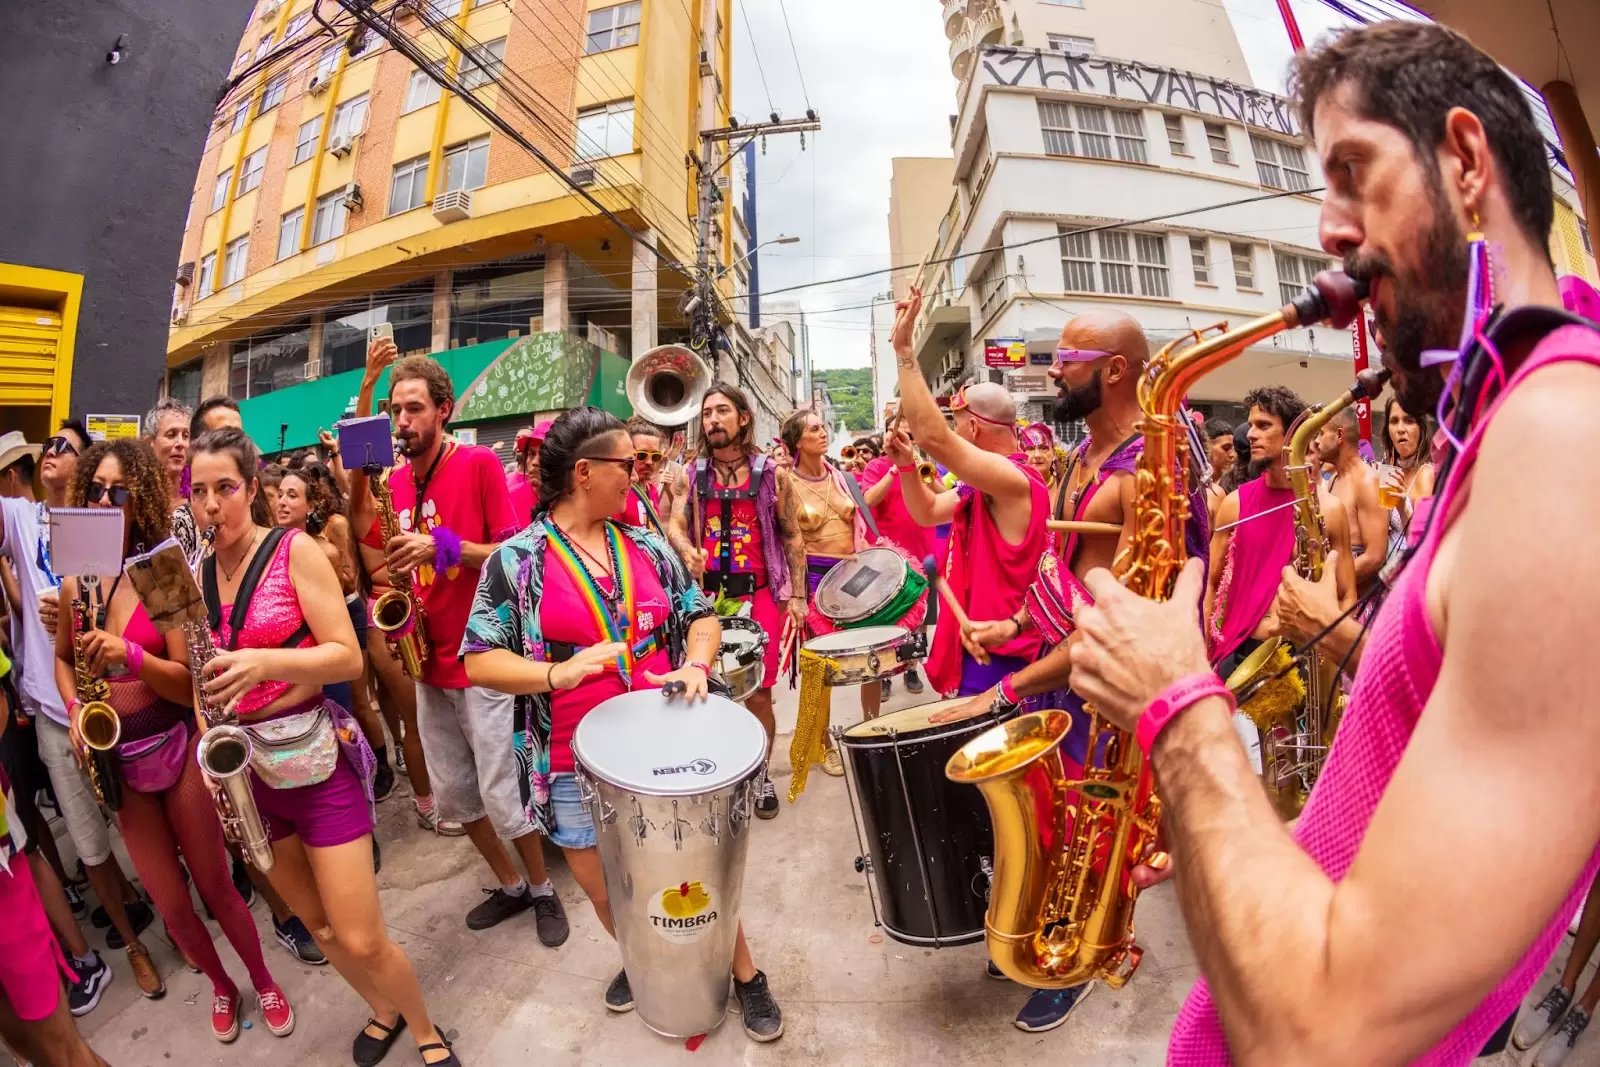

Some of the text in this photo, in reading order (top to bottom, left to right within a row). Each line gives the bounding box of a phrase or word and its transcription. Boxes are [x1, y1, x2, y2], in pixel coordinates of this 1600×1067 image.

[1351, 319, 1360, 360] CIDAD
[652, 765, 697, 776] LUEN
[650, 911, 717, 928] TIMBRA
